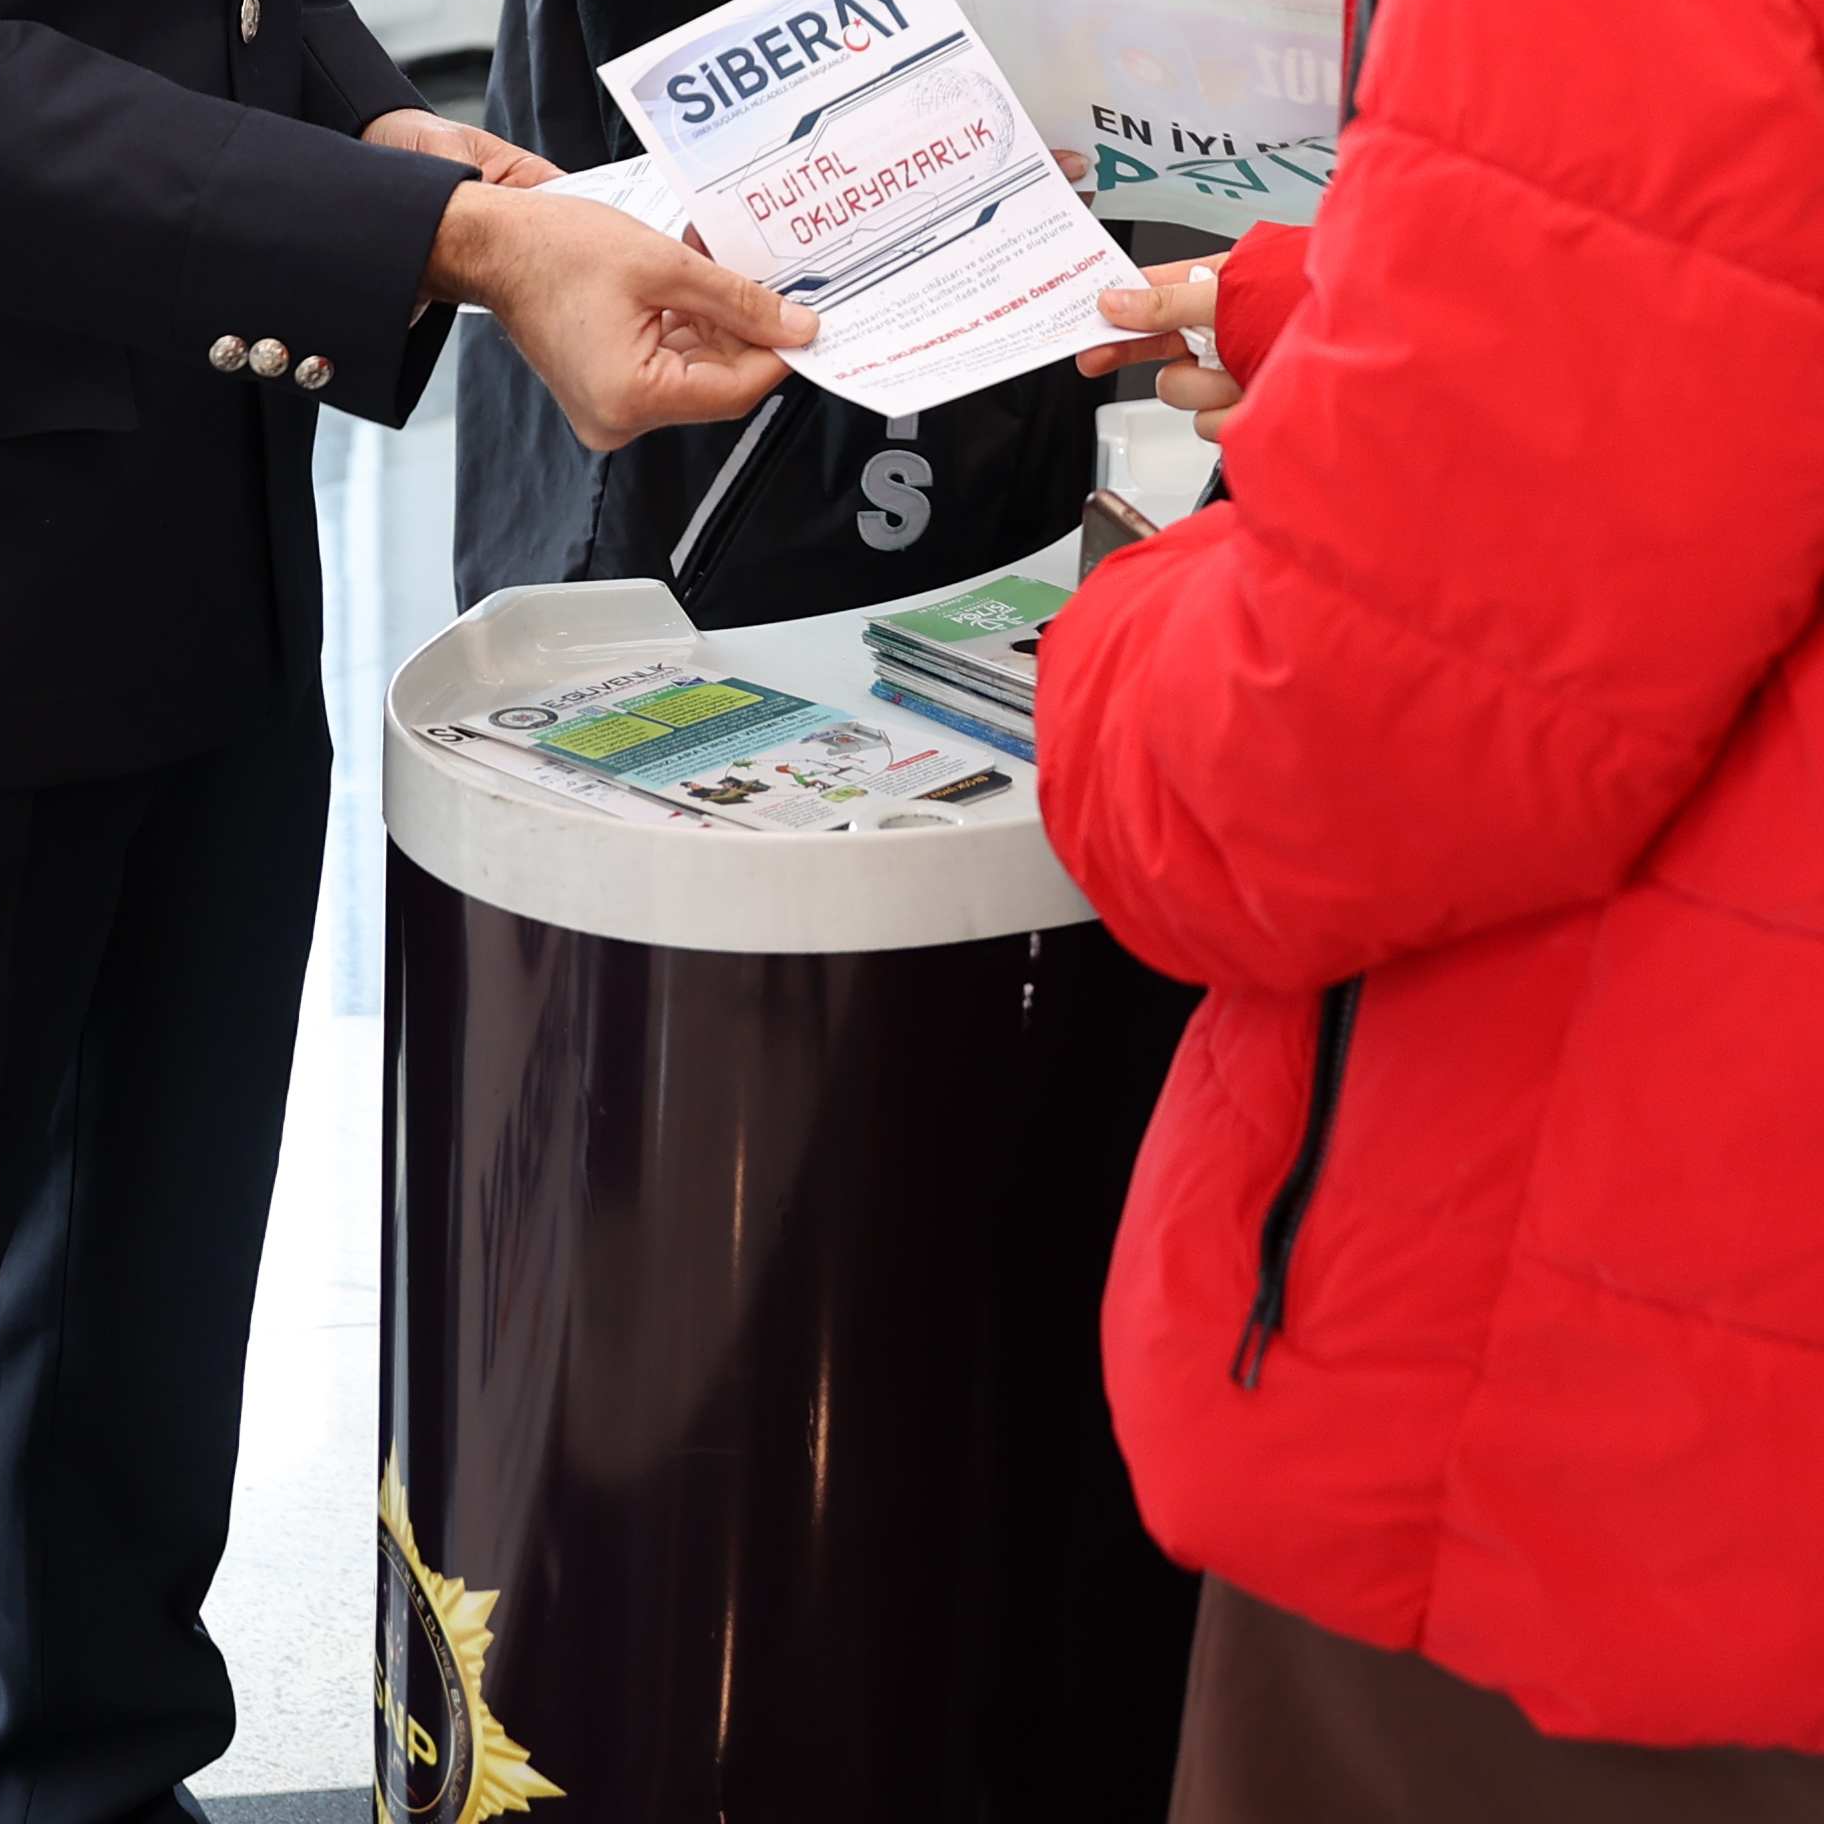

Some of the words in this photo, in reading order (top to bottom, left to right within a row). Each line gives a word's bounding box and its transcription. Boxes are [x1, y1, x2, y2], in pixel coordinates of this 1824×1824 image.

[748, 83, 790, 109] MÜCADELE
[1091, 104, 1153, 146] EN
[746, 152, 857, 221] DİJİTAL
[790, 118, 994, 245] OKURYAZARLIK
[964, 260, 976, 271] ve
[975, 253, 1011, 278] anlama
[1012, 247, 1024, 257] ve
[1024, 219, 1075, 252] oluşturma
[983, 294, 1029, 322] NEDEN
